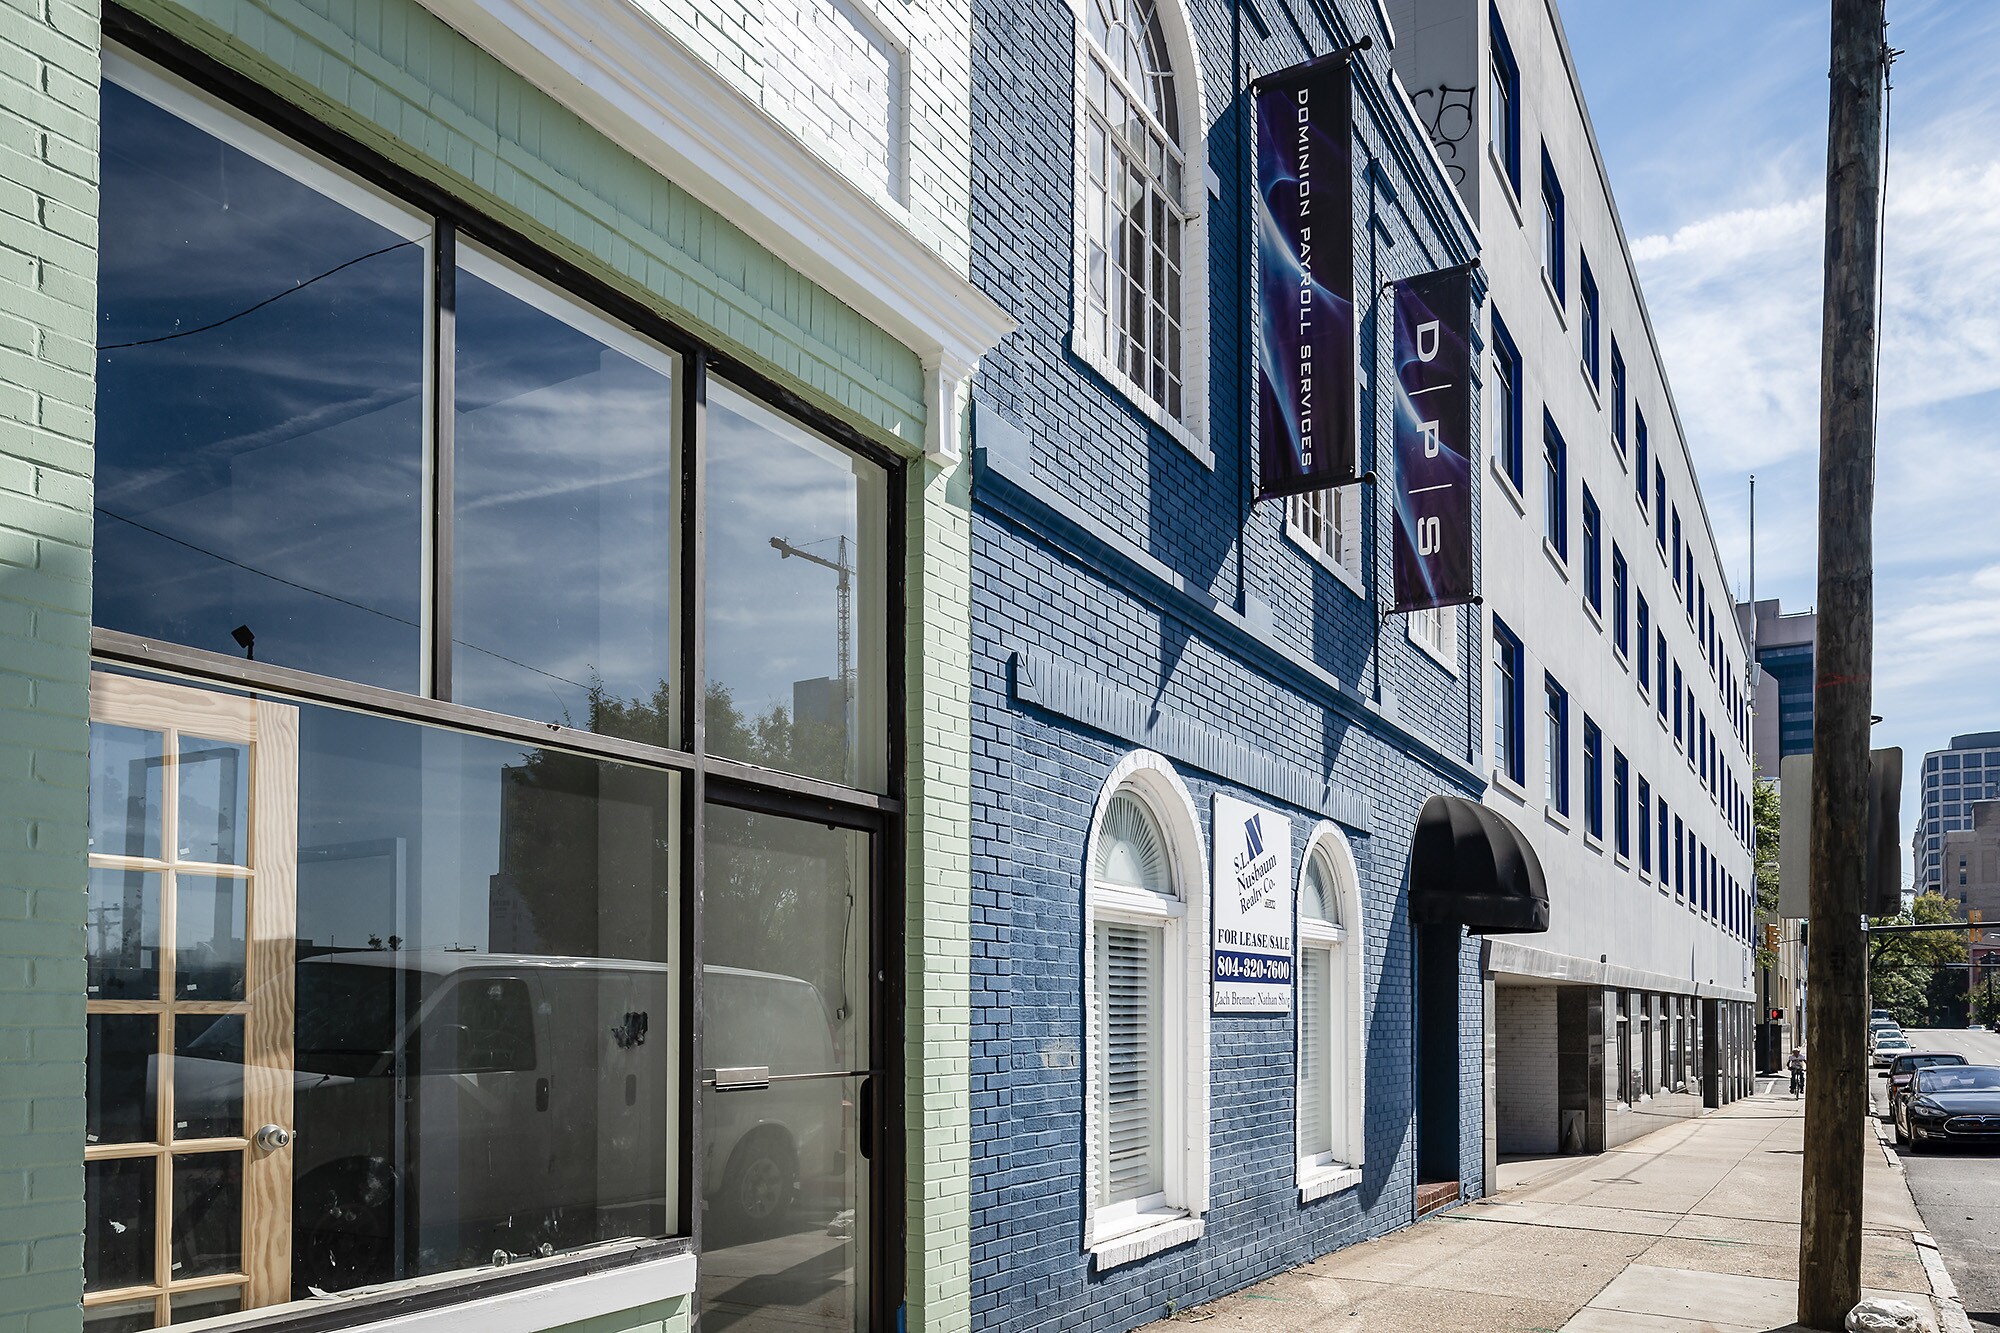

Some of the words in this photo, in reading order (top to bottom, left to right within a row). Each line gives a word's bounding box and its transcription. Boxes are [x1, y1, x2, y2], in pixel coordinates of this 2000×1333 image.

[1297, 88, 1310, 217] DOMINION
[1300, 226, 1312, 336] PAYROLL
[1300, 344, 1312, 467] SERVICES
[1236, 854, 1277, 896] Nusbaum
[1239, 887, 1263, 915] Realty
[1263, 877, 1276, 894] Co.
[1217, 928, 1238, 945] FOR
[1216, 955, 1290, 980] 804-320-7600
[1214, 990, 1230, 1007] Zach
